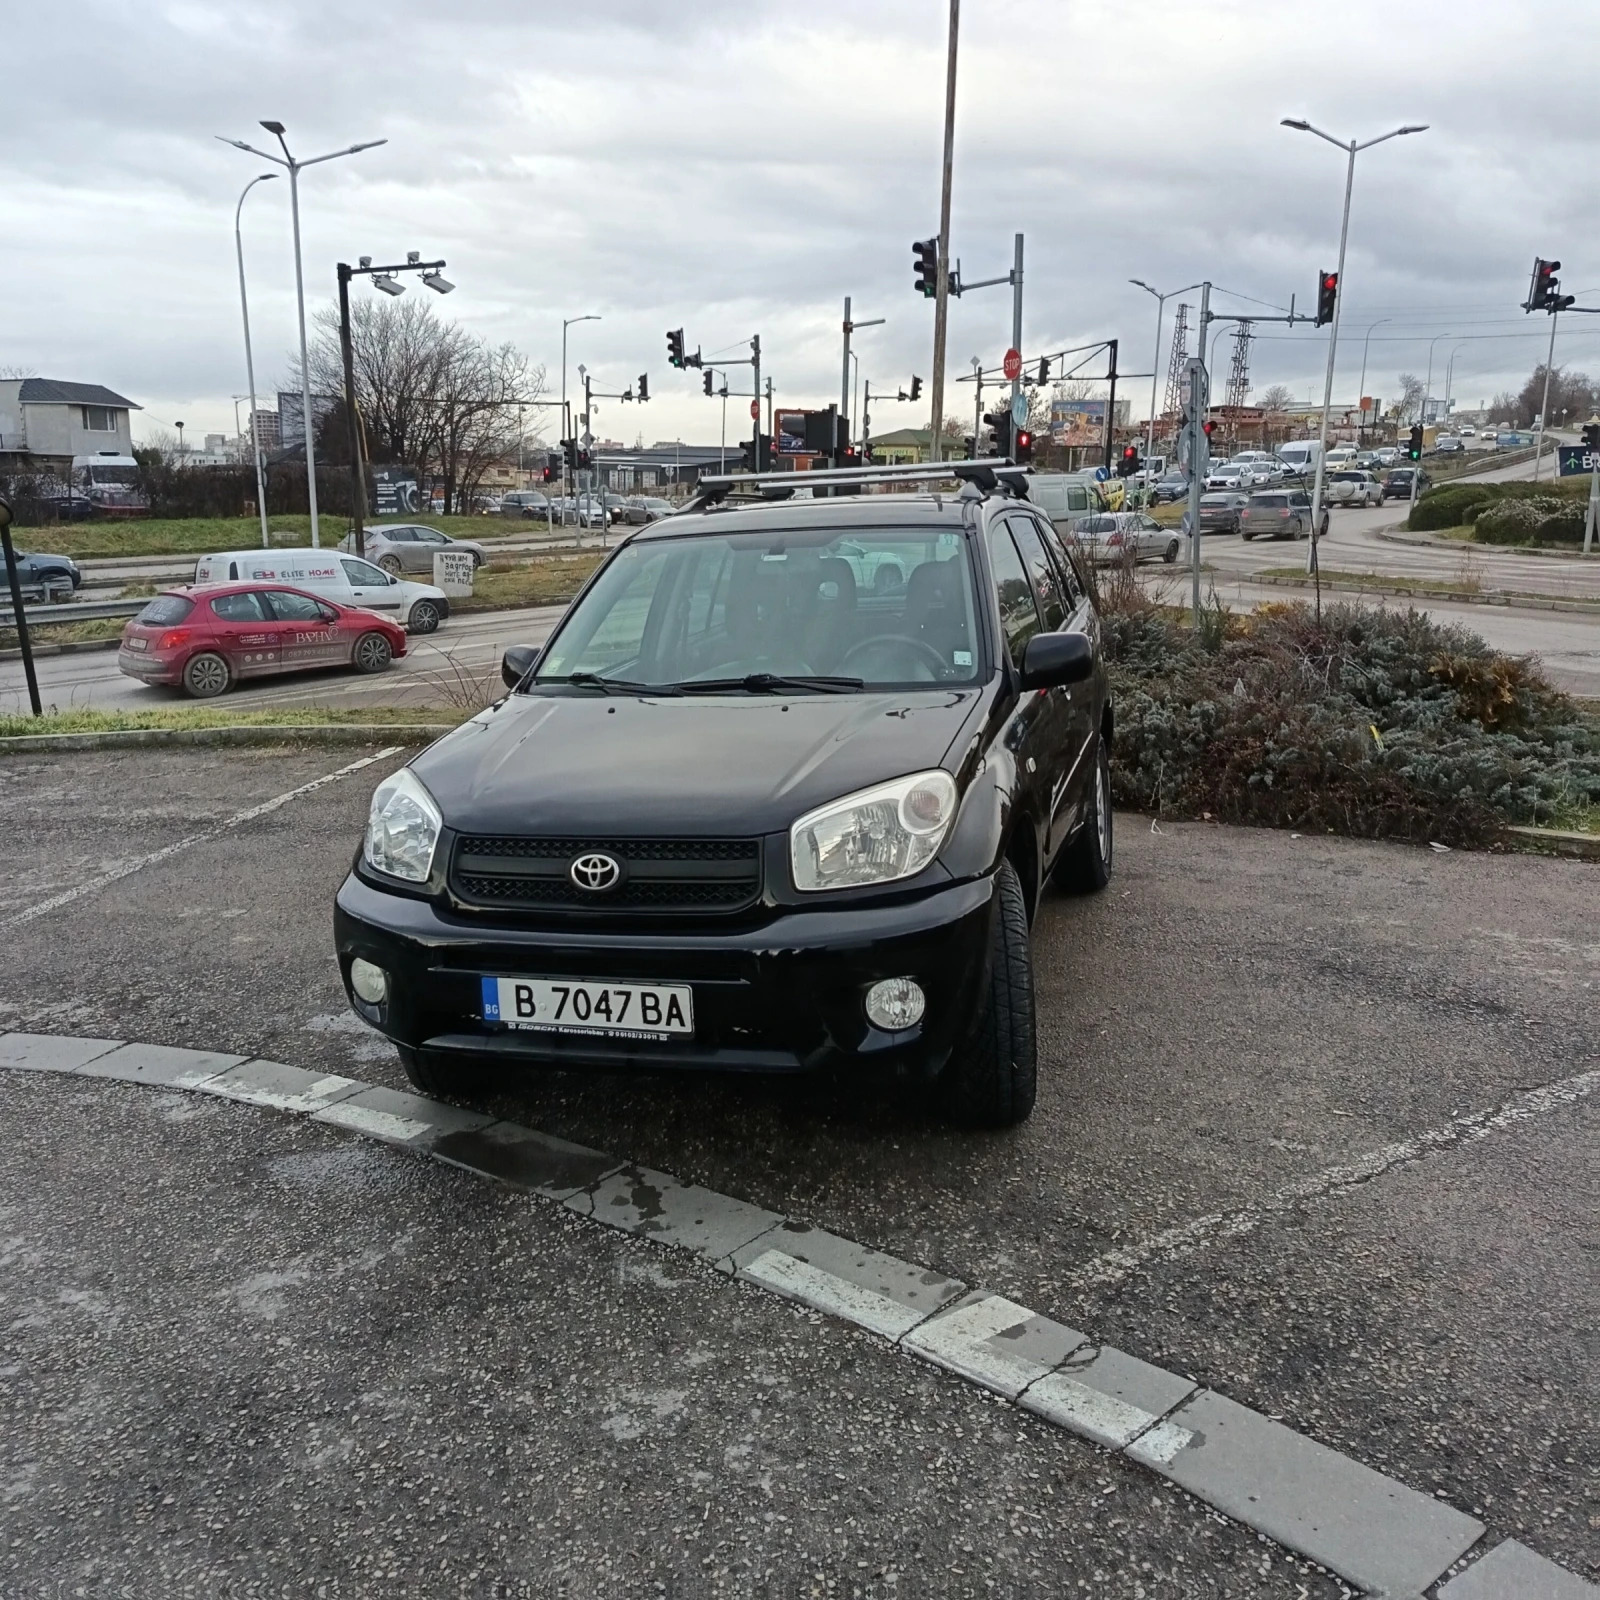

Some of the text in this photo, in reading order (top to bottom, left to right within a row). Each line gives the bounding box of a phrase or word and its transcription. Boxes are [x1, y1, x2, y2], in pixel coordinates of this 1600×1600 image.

[1004, 357, 1020, 372] STOP
[281, 568, 335, 578] ELITE HOME
[485, 1003, 499, 1015] BG
[515, 985, 686, 1027] B 7047 BA
[558, 1026, 604, 1036] Karosseriebau
